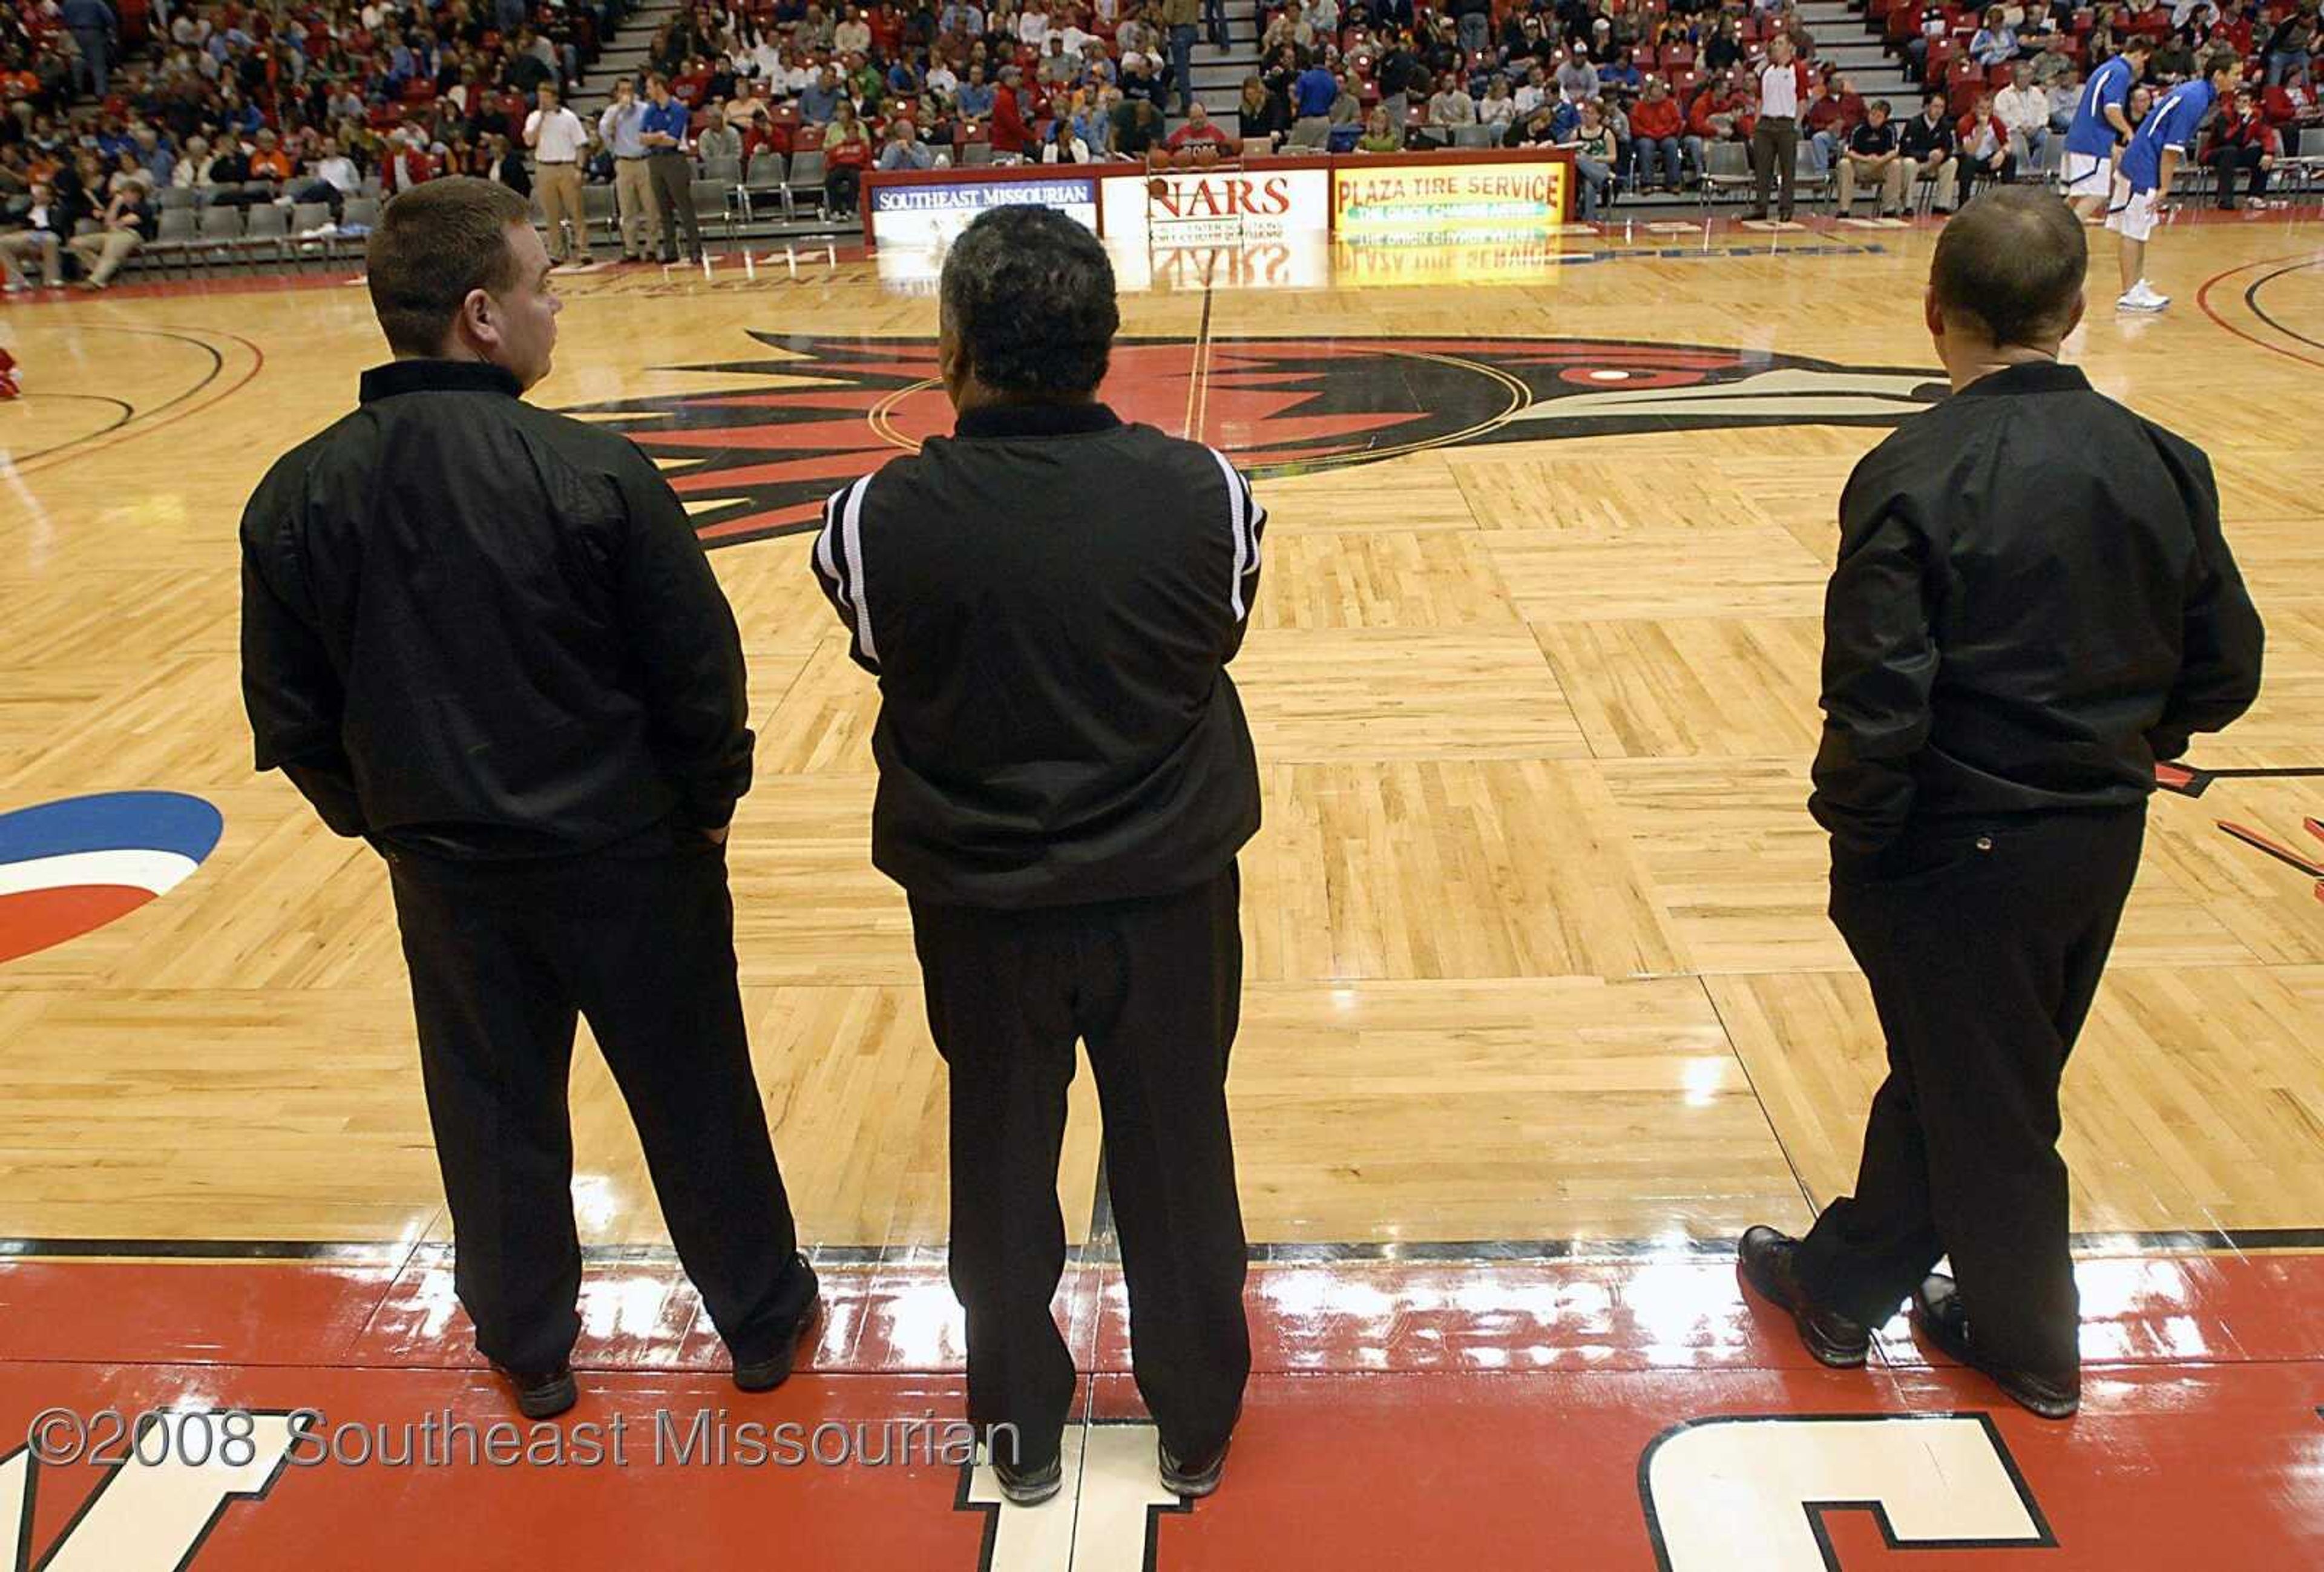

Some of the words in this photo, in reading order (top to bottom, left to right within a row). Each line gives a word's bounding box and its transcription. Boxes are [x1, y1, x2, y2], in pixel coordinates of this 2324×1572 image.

[879, 190, 979, 210] SOUTHEAST
[983, 186, 1088, 205] MISSOURIAN
[1144, 177, 1290, 218] NARS
[1338, 179, 1407, 214] PLAZA
[1414, 177, 1459, 196] TIRE
[1467, 174, 1559, 208] SERVICE
